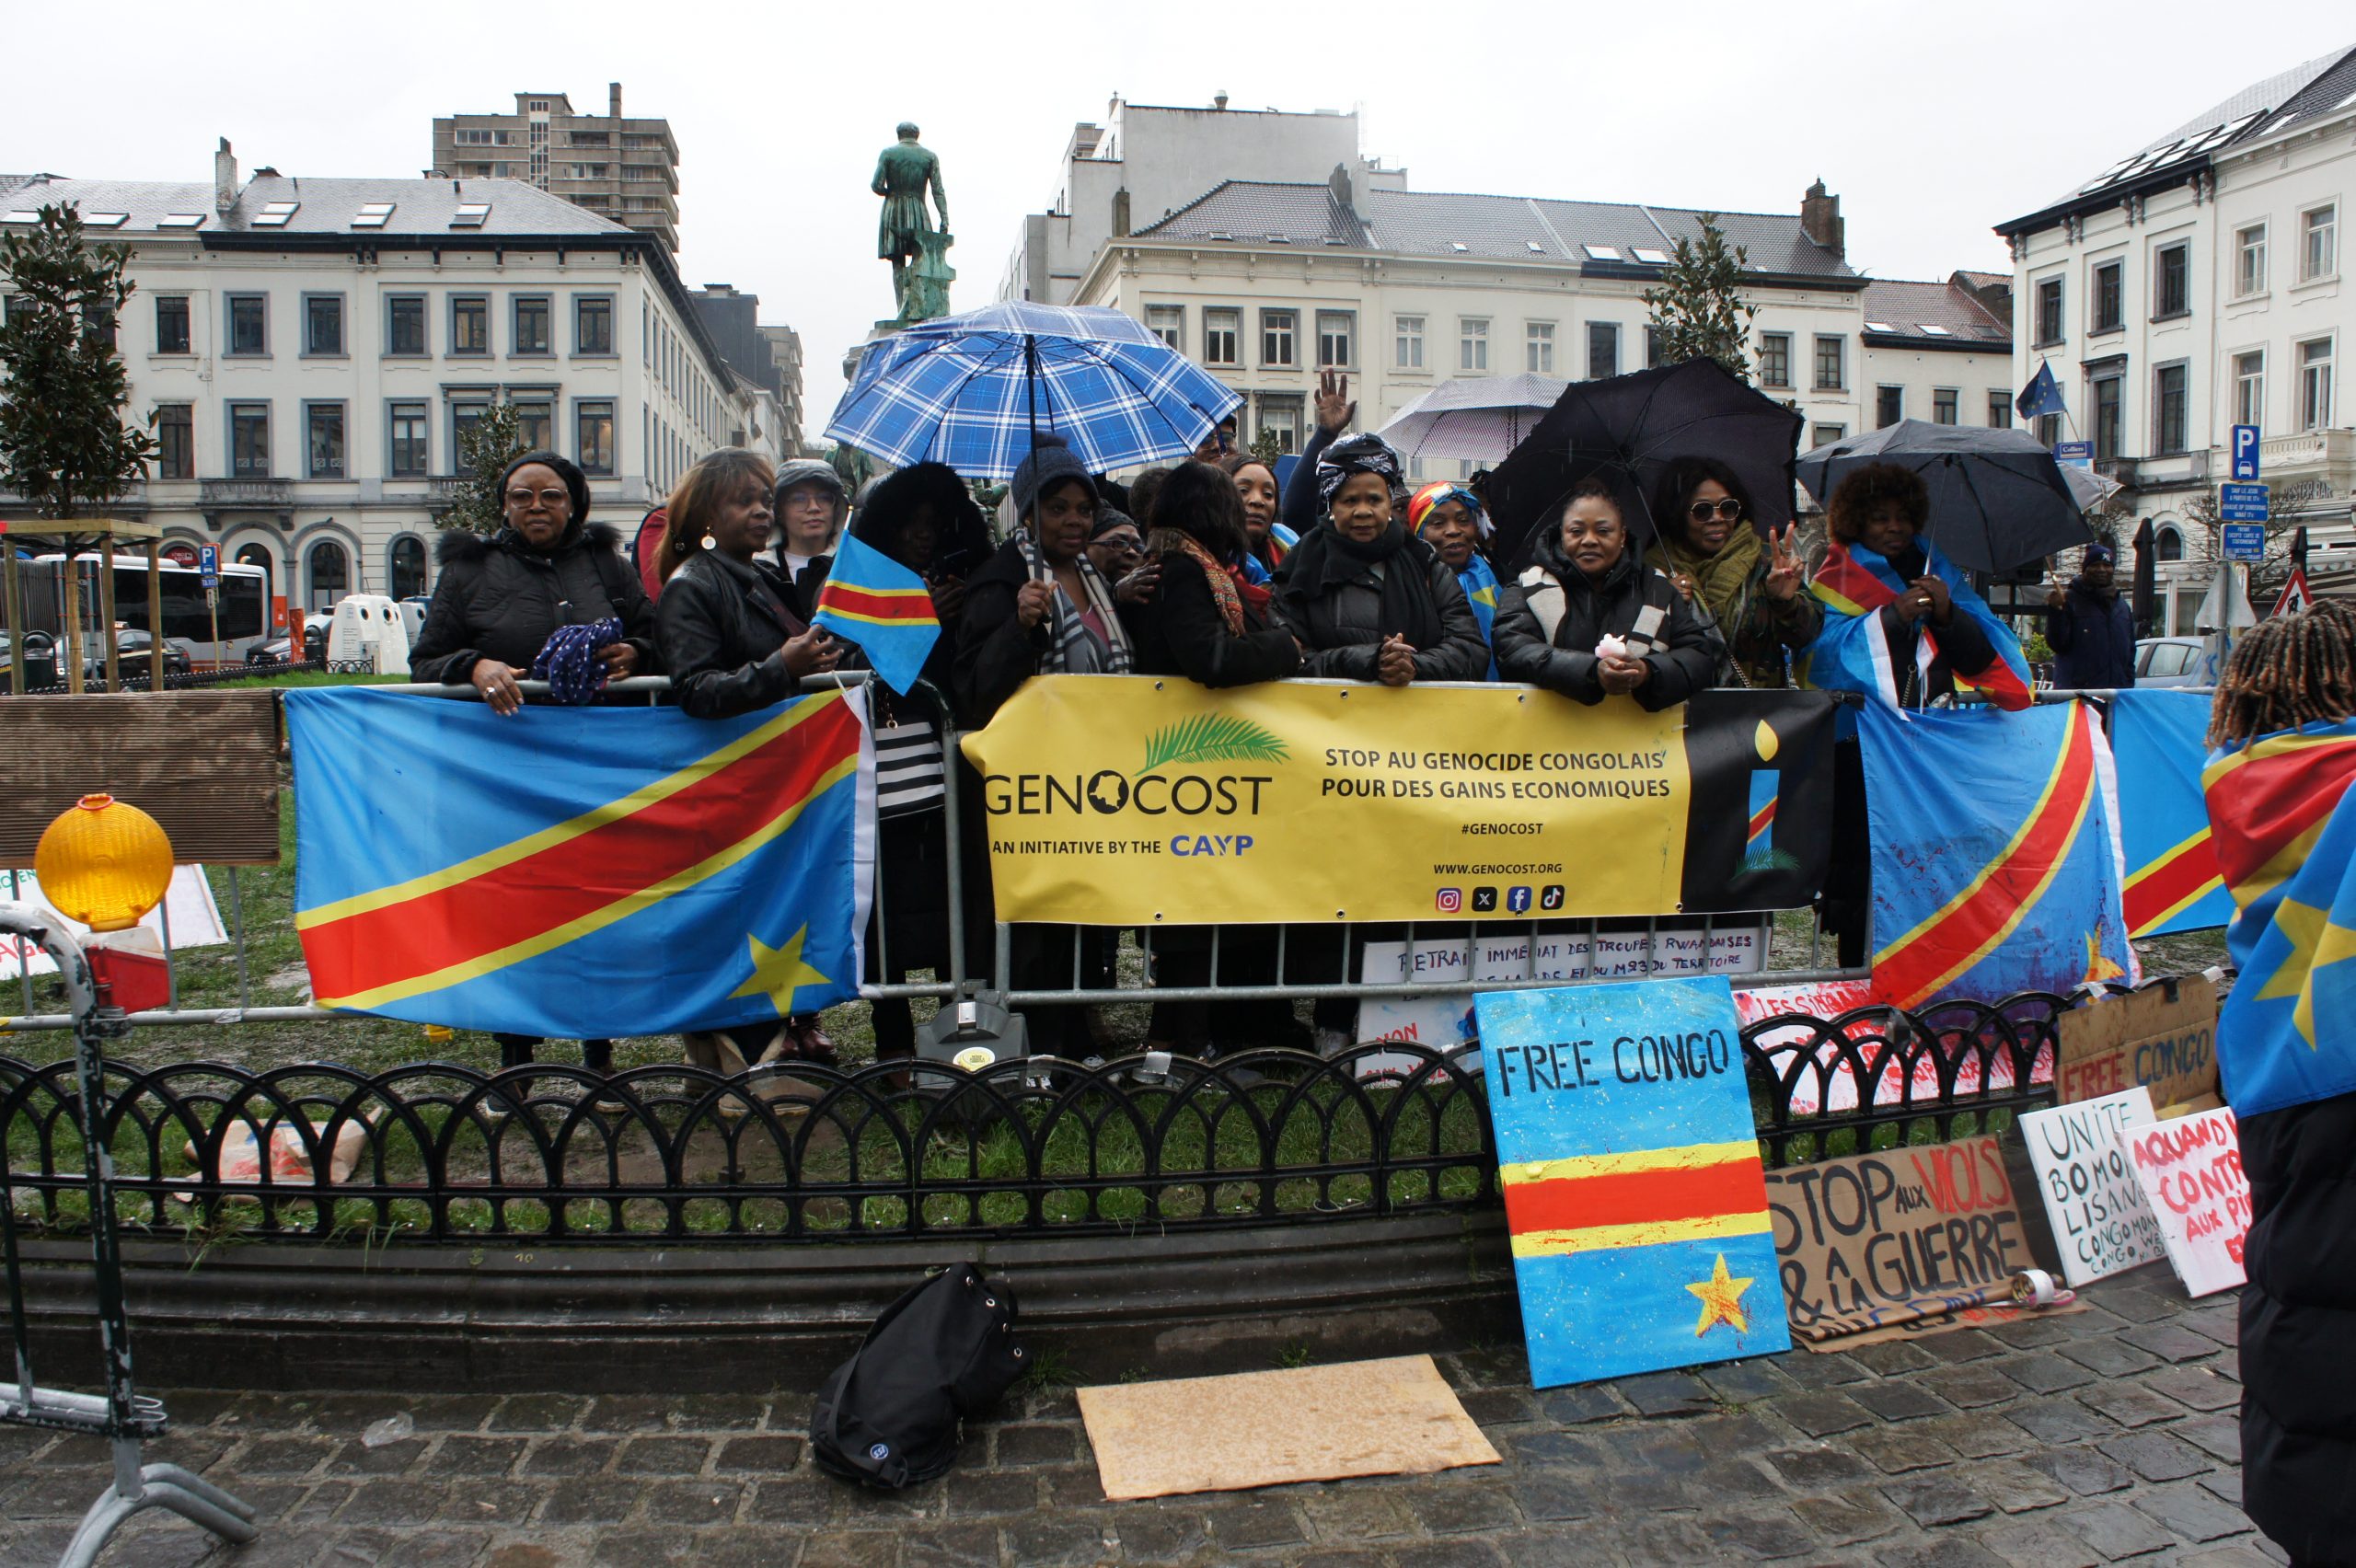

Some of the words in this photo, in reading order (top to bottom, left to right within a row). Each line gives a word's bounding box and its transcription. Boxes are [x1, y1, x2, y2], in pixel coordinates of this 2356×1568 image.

[2315, 480, 2334, 500] BAR
[1325, 748, 1380, 767] STOP
[1389, 751, 1416, 769] AU
[1423, 752, 1533, 771] GENOCIDE
[1540, 751, 1661, 771] CONGOLAIS
[985, 769, 1273, 815] GENOCOST
[1322, 778, 1386, 798] POUR
[1392, 780, 1434, 798] DES
[1440, 781, 1506, 799] GAINS
[1512, 780, 1670, 800] ECONOMIQUES
[1461, 823, 1543, 835] #GENOCOST
[992, 840, 1015, 854] AN
[1020, 841, 1104, 854] INITIATIVE
[1108, 841, 1127, 854] BY
[1131, 840, 1161, 854] THE
[1170, 835, 1253, 857] CAYP
[1433, 862, 1563, 875] WWW.GENOCOST.ORG
[1567, 943, 1589, 955] DES
[1496, 1040, 1600, 1097] FREE
[1612, 1029, 1729, 1084] CONGO
[2063, 1051, 2129, 1104] FREE
[2134, 1028, 2211, 1088] CONGO
[1910, 1139, 2013, 1214] VIOLS
[1764, 1159, 1896, 1256] STOP
[1895, 1183, 1931, 1215] AUX
[2186, 1207, 2223, 1243] AUX
[1779, 1259, 1835, 1327] &
[1829, 1277, 1876, 1316] LA
[1864, 1210, 2027, 1302] GUERRE
